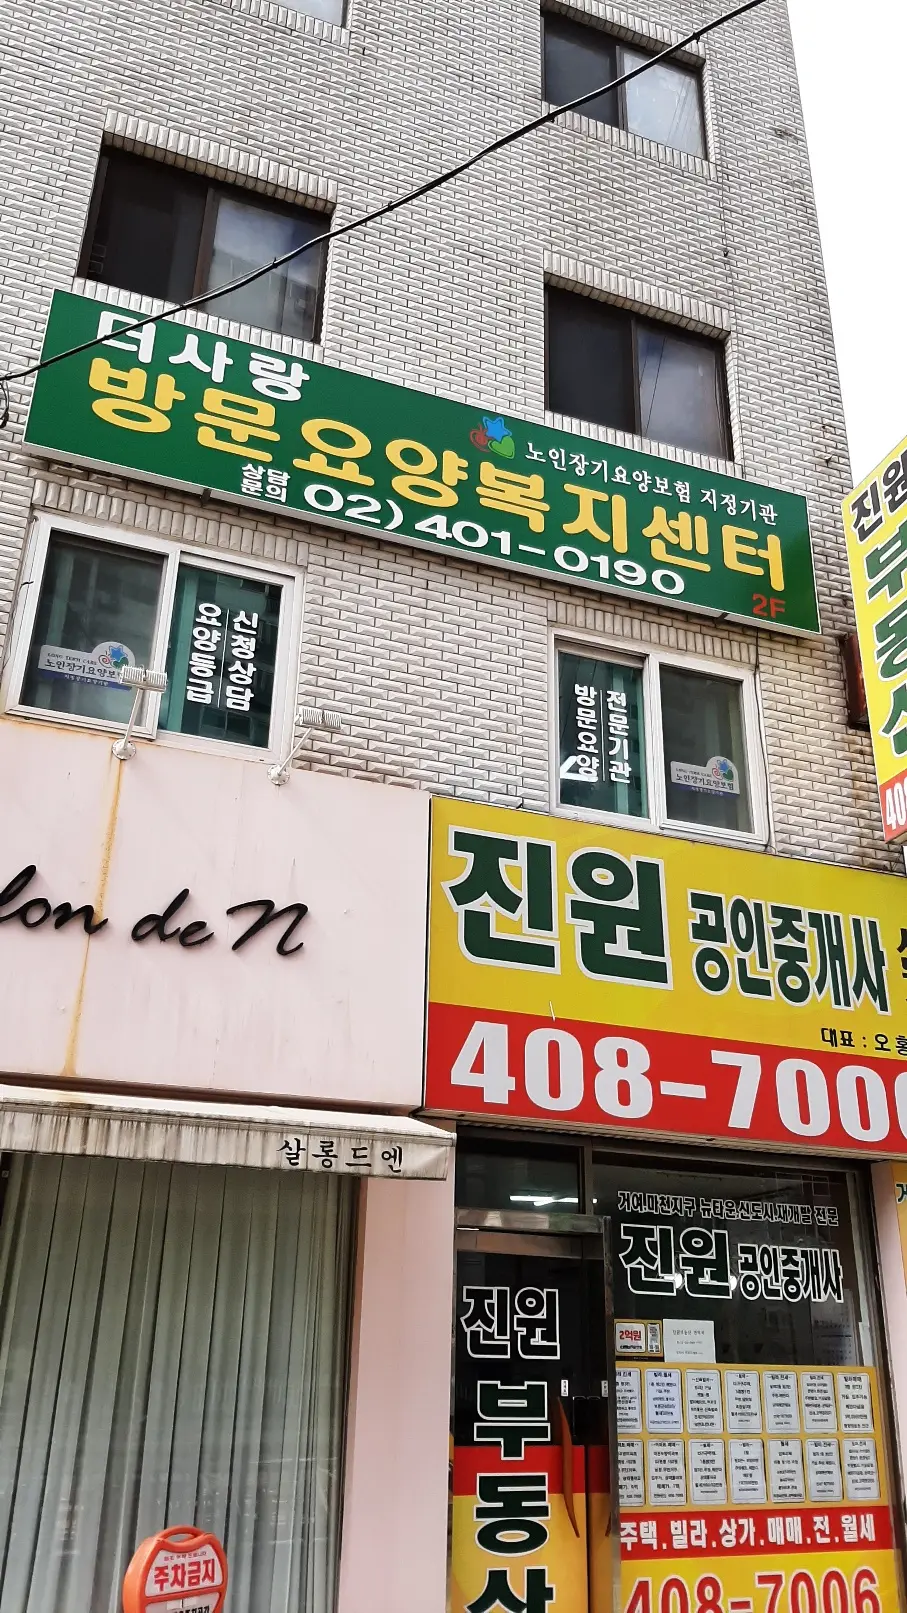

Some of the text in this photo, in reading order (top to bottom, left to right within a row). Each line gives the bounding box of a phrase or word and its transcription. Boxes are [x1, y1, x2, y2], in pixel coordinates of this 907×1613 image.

[97, 310, 310, 402] 더사랑
[88, 357, 785, 592] 방문요양복지센터
[240, 479, 287, 503] 문의
[241, 463, 291, 486] 상담
[525, 443, 778, 526] 노인장기요양보험 지정기관
[752, 592, 786, 618] 2F
[44, 658, 122, 679] 노인장기요양보
[186, 602, 222, 705] 요양등급
[225, 610, 259, 712] 신청상담
[574, 683, 600, 782] 방문요양
[606, 690, 632, 784] 전문기관
[131, 888, 215, 947] de
[441, 825, 673, 990] 진원
[686, 888, 892, 1016] 공인중개사
[821, 1027, 855, 1048] 대표
[450, 1021, 907, 1143] 408-700
[277, 1136, 404, 1173] 살롱드엔
[814, 1205, 839, 1227] 전문
[618, 1223, 844, 1304] 진원 공인중개사
[460, 1286, 561, 1360] 진원
[619, 1329, 642, 1342] 2억원
[154, 1558, 215, 1592] 주차금지
